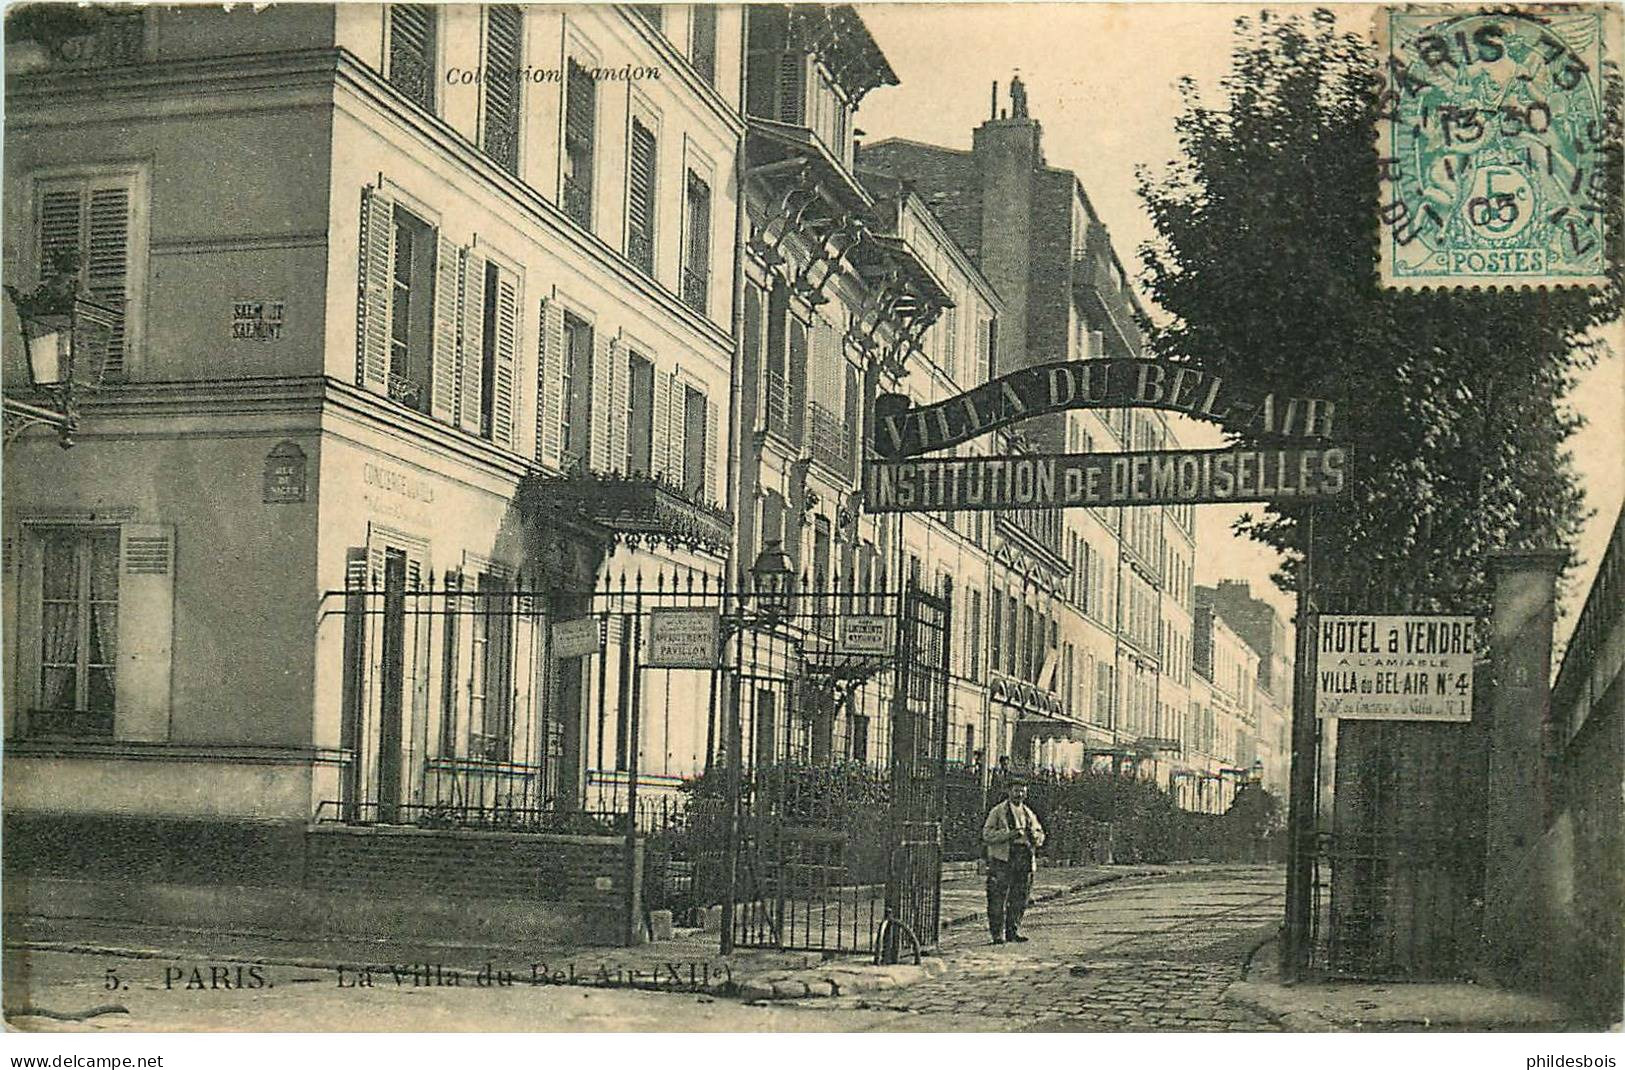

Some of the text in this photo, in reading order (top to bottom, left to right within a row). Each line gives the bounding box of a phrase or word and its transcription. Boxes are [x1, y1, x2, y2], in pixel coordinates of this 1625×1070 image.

[1452, 251, 1544, 273] POSTES
[883, 378, 1025, 452] VILLA
[1048, 362, 1111, 407] DU
[869, 447, 1346, 507] INSTITUTION DE DEMOISELLES
[1405, 621, 1474, 654] VENDRE
[1321, 671, 1358, 693] VILLA
[1455, 673, 1469, 695] 4
